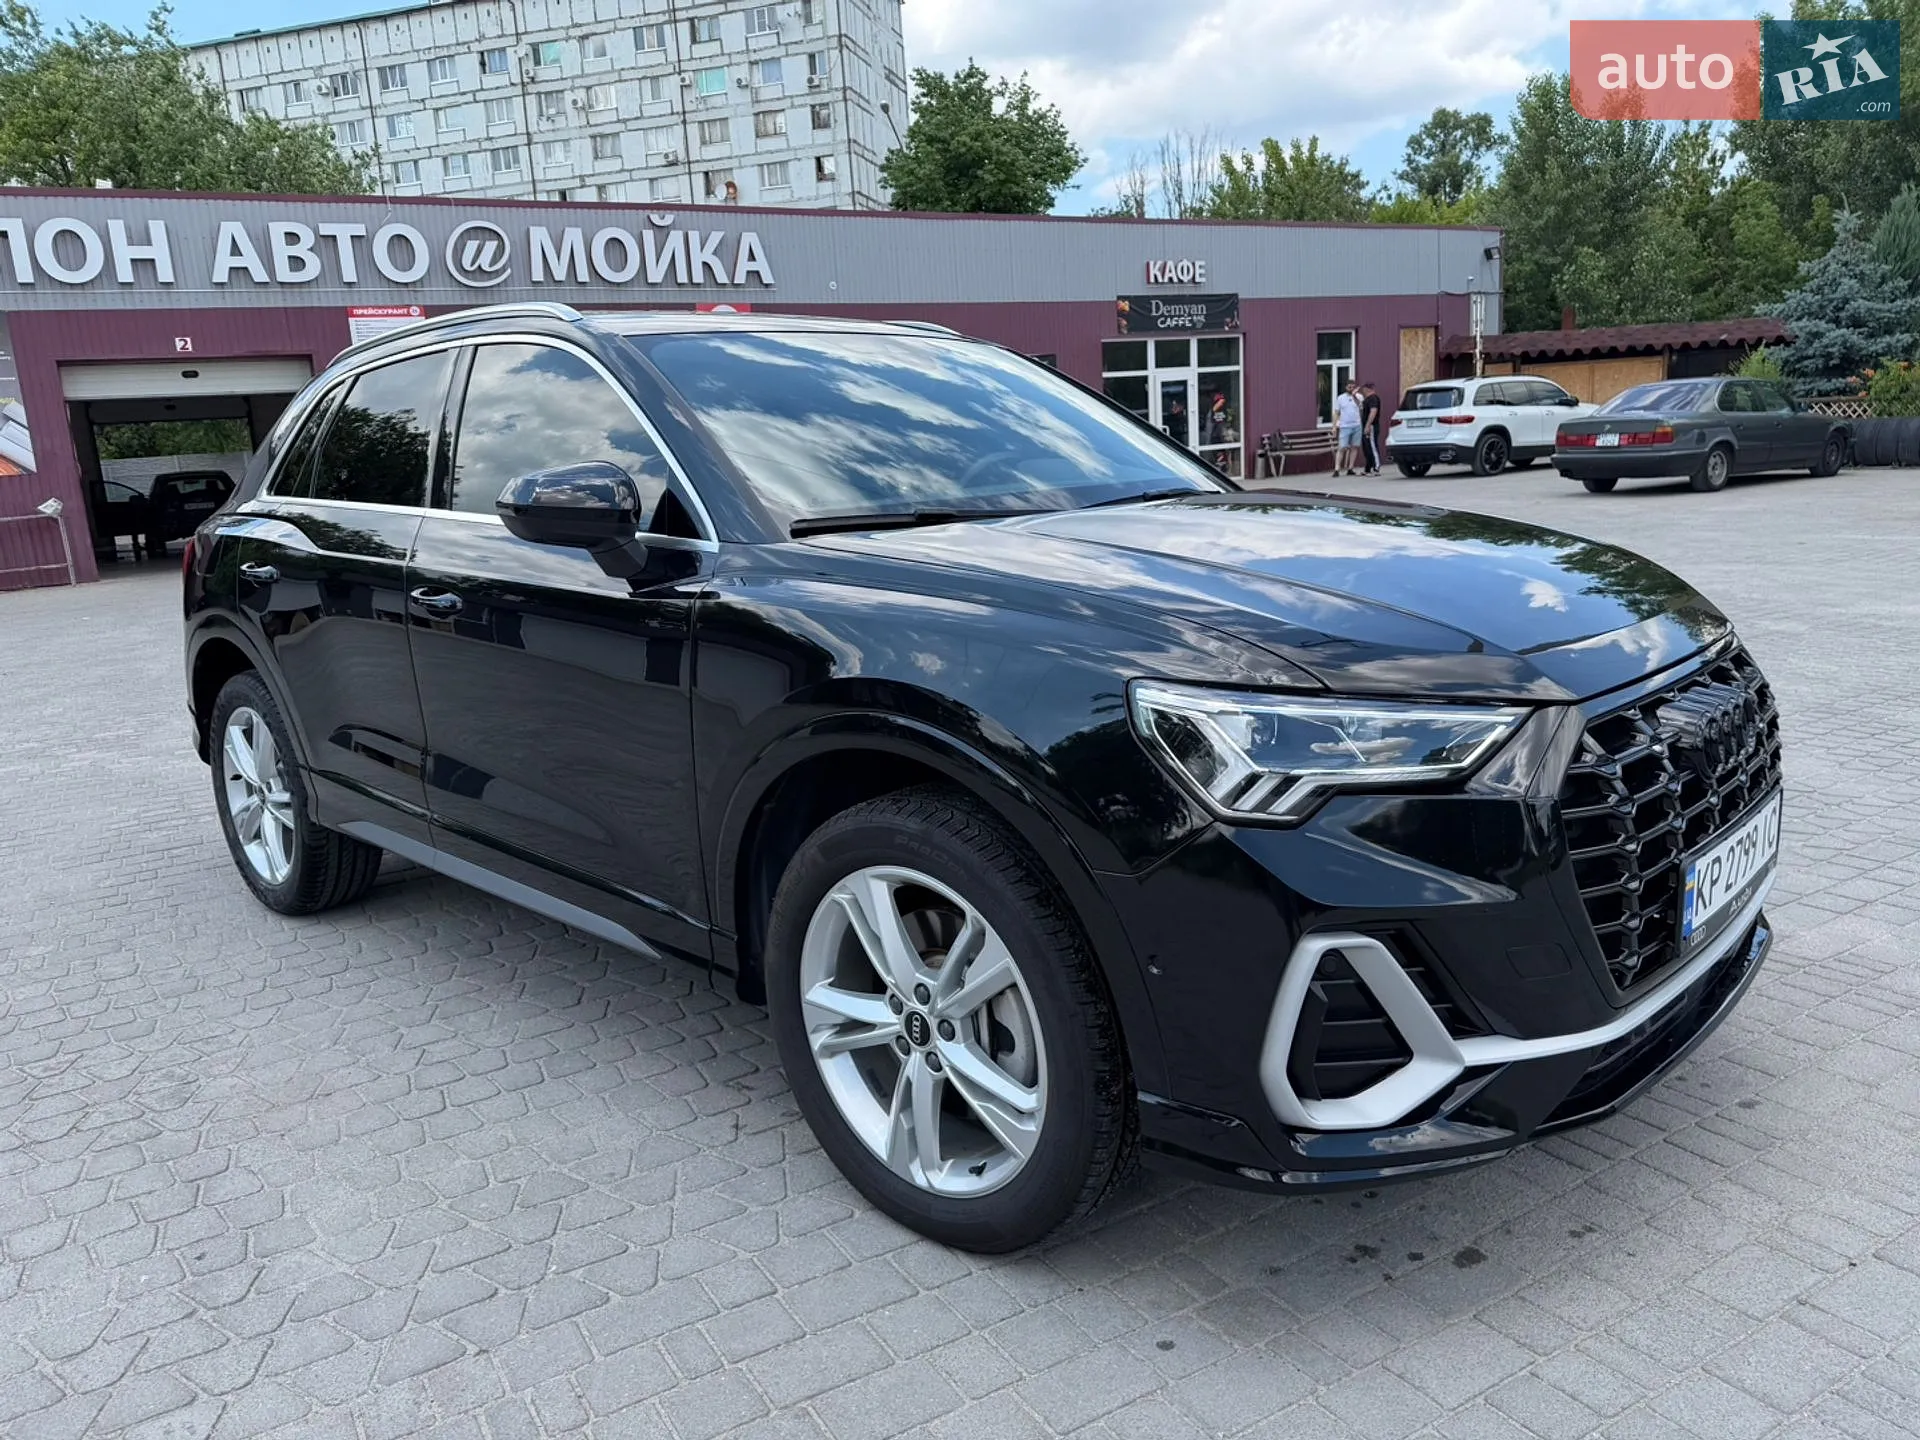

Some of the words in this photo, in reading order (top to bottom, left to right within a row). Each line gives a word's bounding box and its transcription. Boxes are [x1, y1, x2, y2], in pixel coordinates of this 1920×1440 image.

[211, 221, 430, 284] АВТО
[528, 214, 775, 285] МОЙКА
[1147, 259, 1206, 284] КАФЕ
[353, 307, 408, 315] ПРЕЙСКУРАНТ
[1150, 300, 1207, 317] Demyan
[179, 338, 189, 350] 2
[1694, 855, 1722, 917] KP
[1724, 825, 1758, 893] 2799
